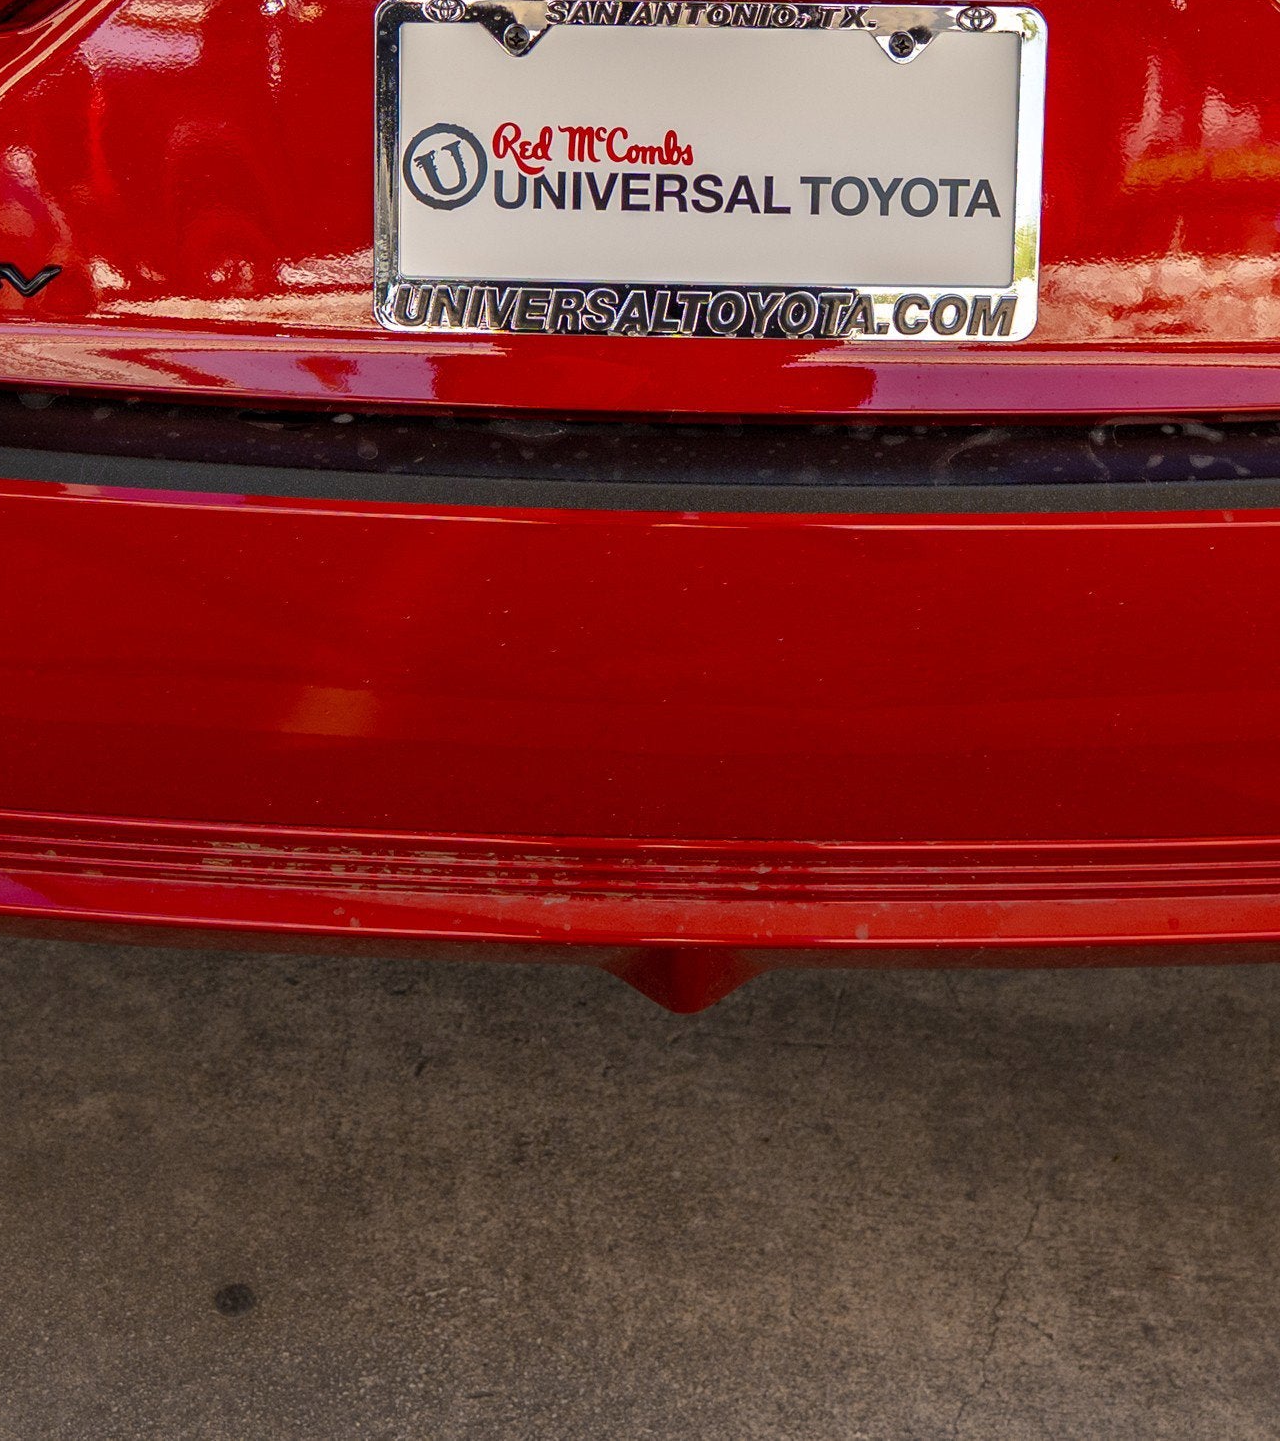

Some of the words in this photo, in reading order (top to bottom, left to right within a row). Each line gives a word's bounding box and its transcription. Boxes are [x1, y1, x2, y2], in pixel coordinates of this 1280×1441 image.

[545, 0, 620, 26] SAN
[634, 1, 810, 28] ANTONIO,
[492, 121, 554, 176] Red
[557, 124, 694, 166] McCombs
[493, 169, 792, 215] UNIVERSAL
[799, 175, 1002, 218] TOYOTA
[393, 283, 1019, 338] UNIVERSALTOYOTA.COM
